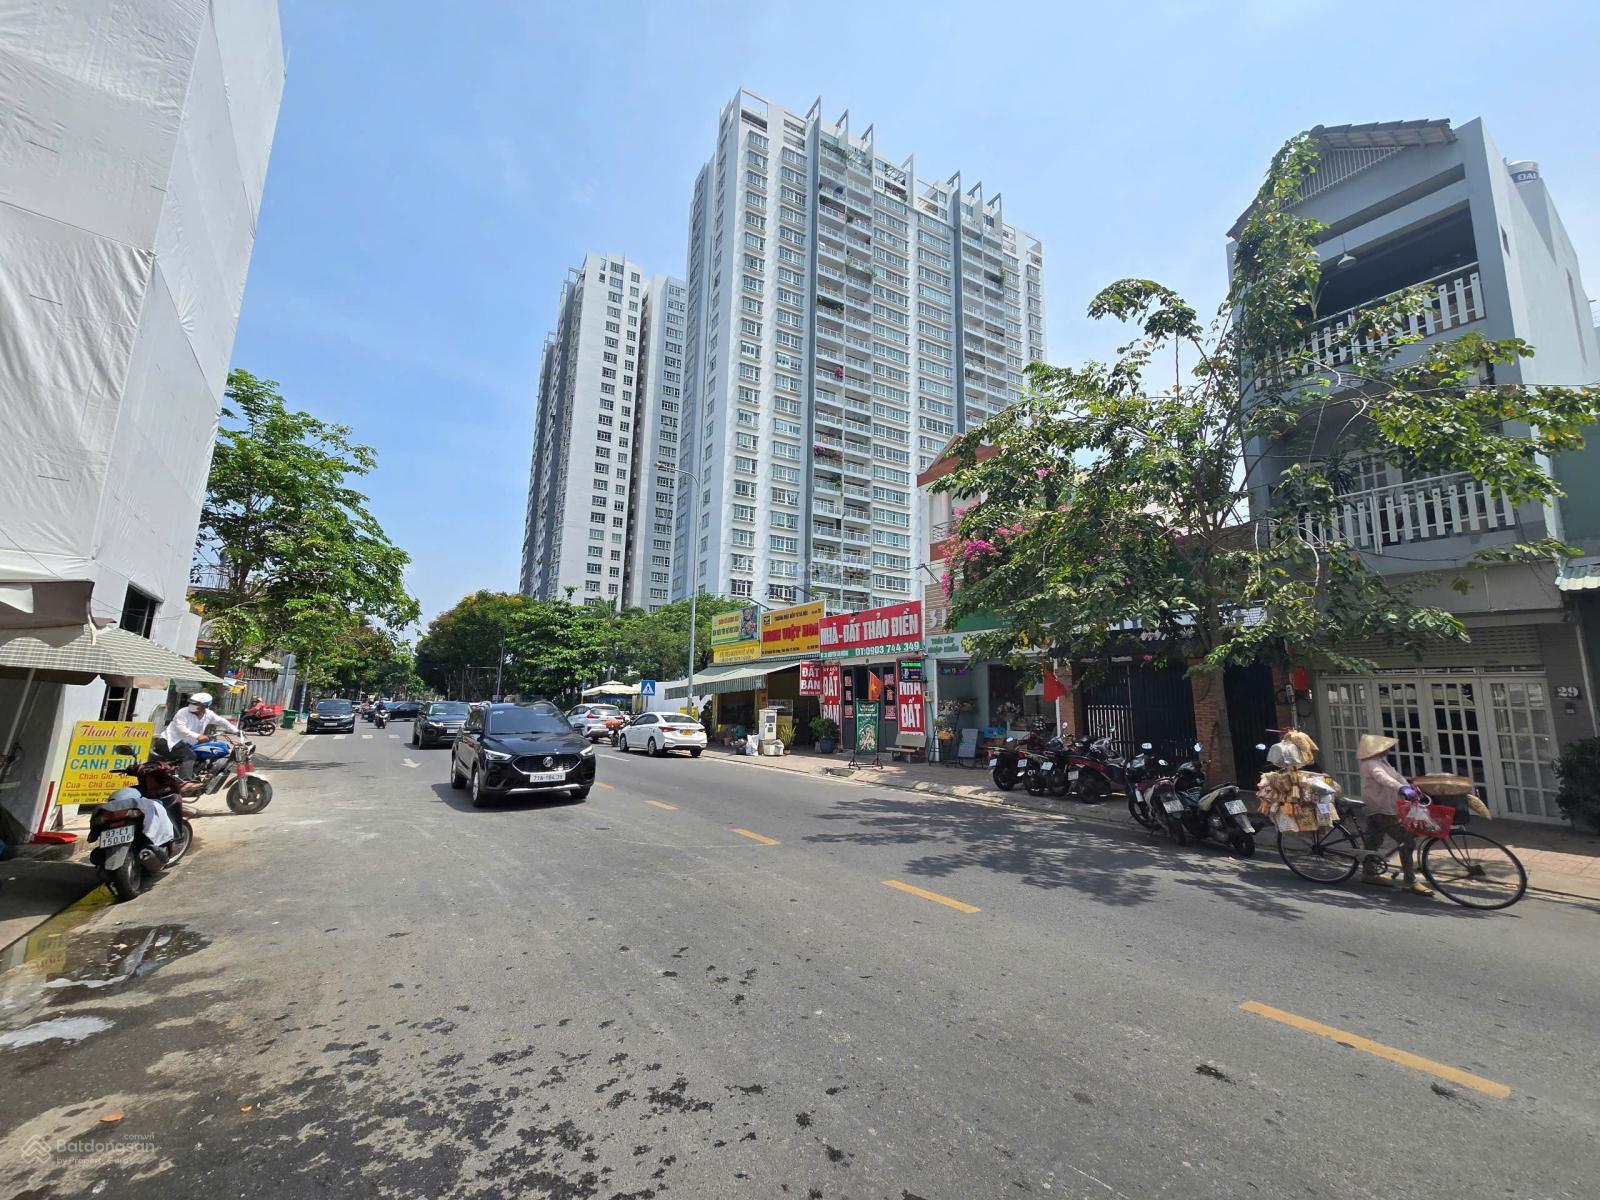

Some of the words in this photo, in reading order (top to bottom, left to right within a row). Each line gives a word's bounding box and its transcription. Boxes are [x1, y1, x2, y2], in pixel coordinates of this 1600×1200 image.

[863, 613, 889, 640] THẢO
[892, 608, 918, 636] ĐIỀN
[887, 644, 901, 653] 744
[904, 641, 920, 651] 349
[802, 666, 820, 677] ĐẤT
[801, 678, 820, 690] BÁN
[823, 671, 838, 697] ĐẤT
[901, 697, 920, 728] ĐẤT
[81, 724, 117, 737] Thanh
[70, 758, 108, 770] CANH
